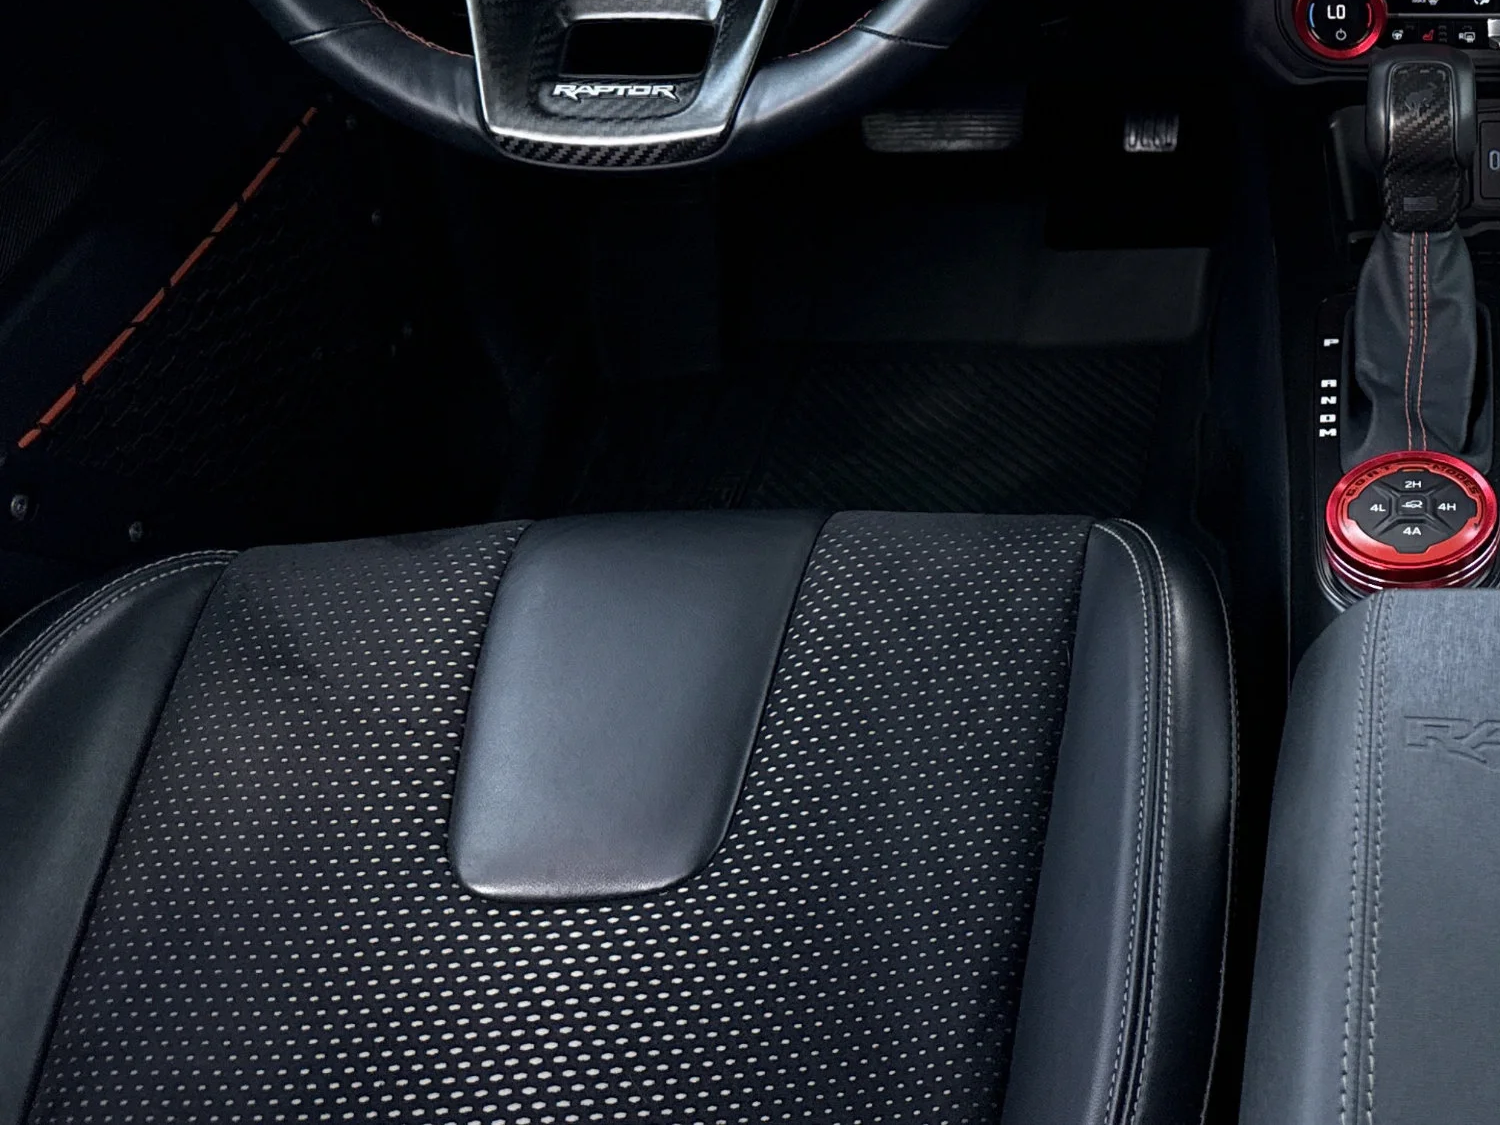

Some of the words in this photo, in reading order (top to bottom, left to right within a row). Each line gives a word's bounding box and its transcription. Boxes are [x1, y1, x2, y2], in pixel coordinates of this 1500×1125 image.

[1327, 4, 1346, 20] LO
[552, 83, 681, 102] RAPTOR
[1323, 338, 1340, 347] P
[1320, 395, 1337, 405] N
[1319, 428, 1337, 437] M
[1404, 480, 1422, 489] 2H
[1370, 503, 1386, 512] 4L
[1437, 503, 1457, 511] 4H
[1402, 526, 1422, 535] 4A
